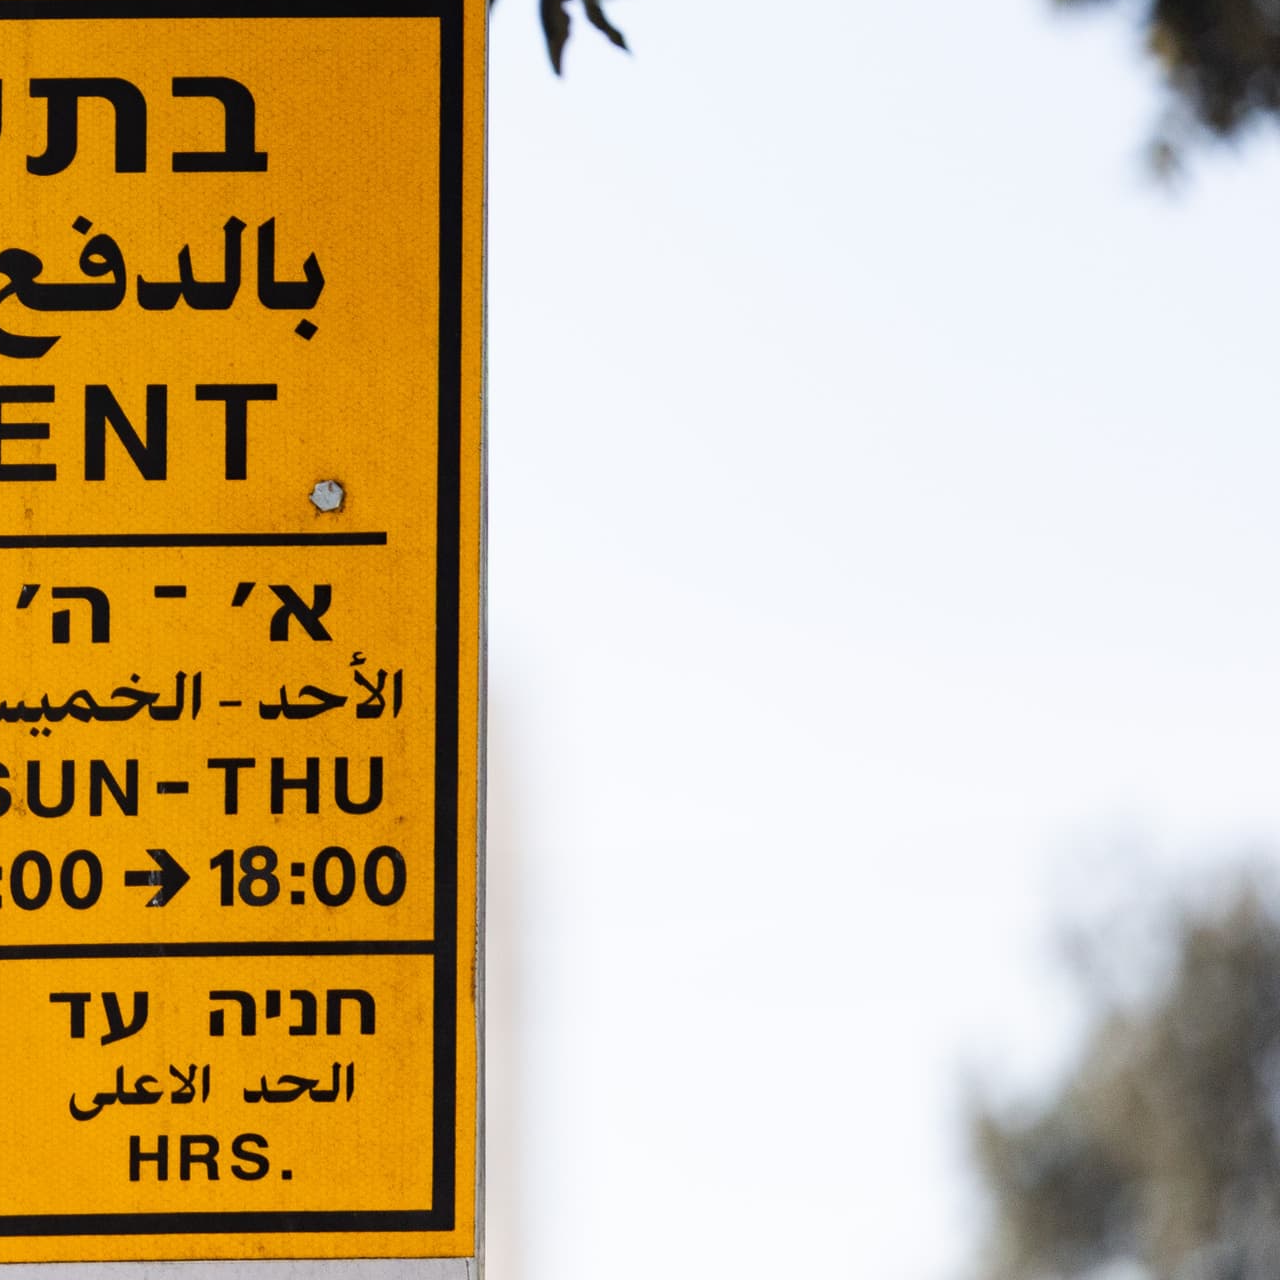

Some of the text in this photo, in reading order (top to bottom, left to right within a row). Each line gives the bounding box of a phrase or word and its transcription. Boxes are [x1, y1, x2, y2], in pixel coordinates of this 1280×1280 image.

[209, 845, 407, 908] 18:00
[49, 988, 376, 1046] חניה עד
[69, 1061, 355, 1122] الحد الاعلى
[129, 1132, 293, 1182] HRS.
